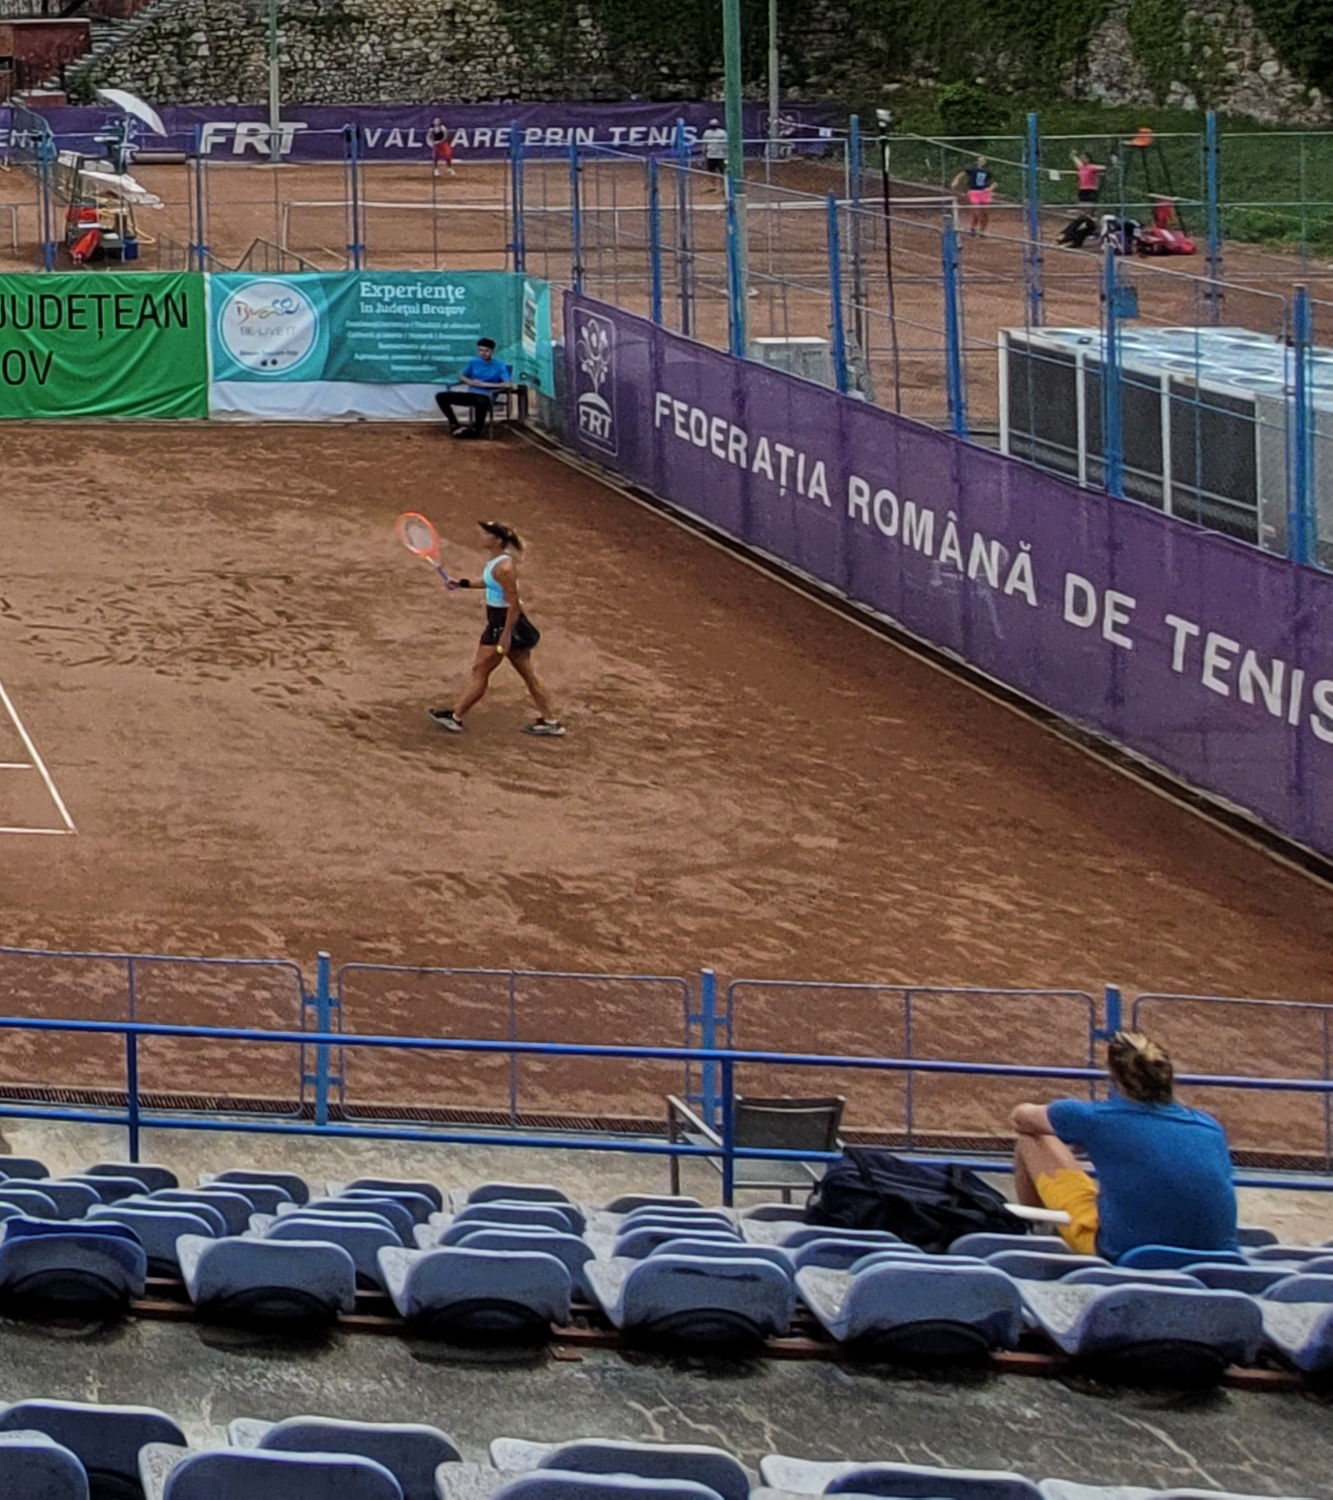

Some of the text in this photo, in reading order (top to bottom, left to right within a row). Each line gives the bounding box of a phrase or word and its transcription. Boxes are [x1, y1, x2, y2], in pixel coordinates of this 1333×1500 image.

[200, 122, 308, 155] FRT
[524, 126, 595, 147] PRIN
[609, 126, 698, 147] TENIS
[578, 403, 613, 440] FRT
[654, 390, 1333, 746] FEDERAȚIA ROMÂNĂ DE TENIS
